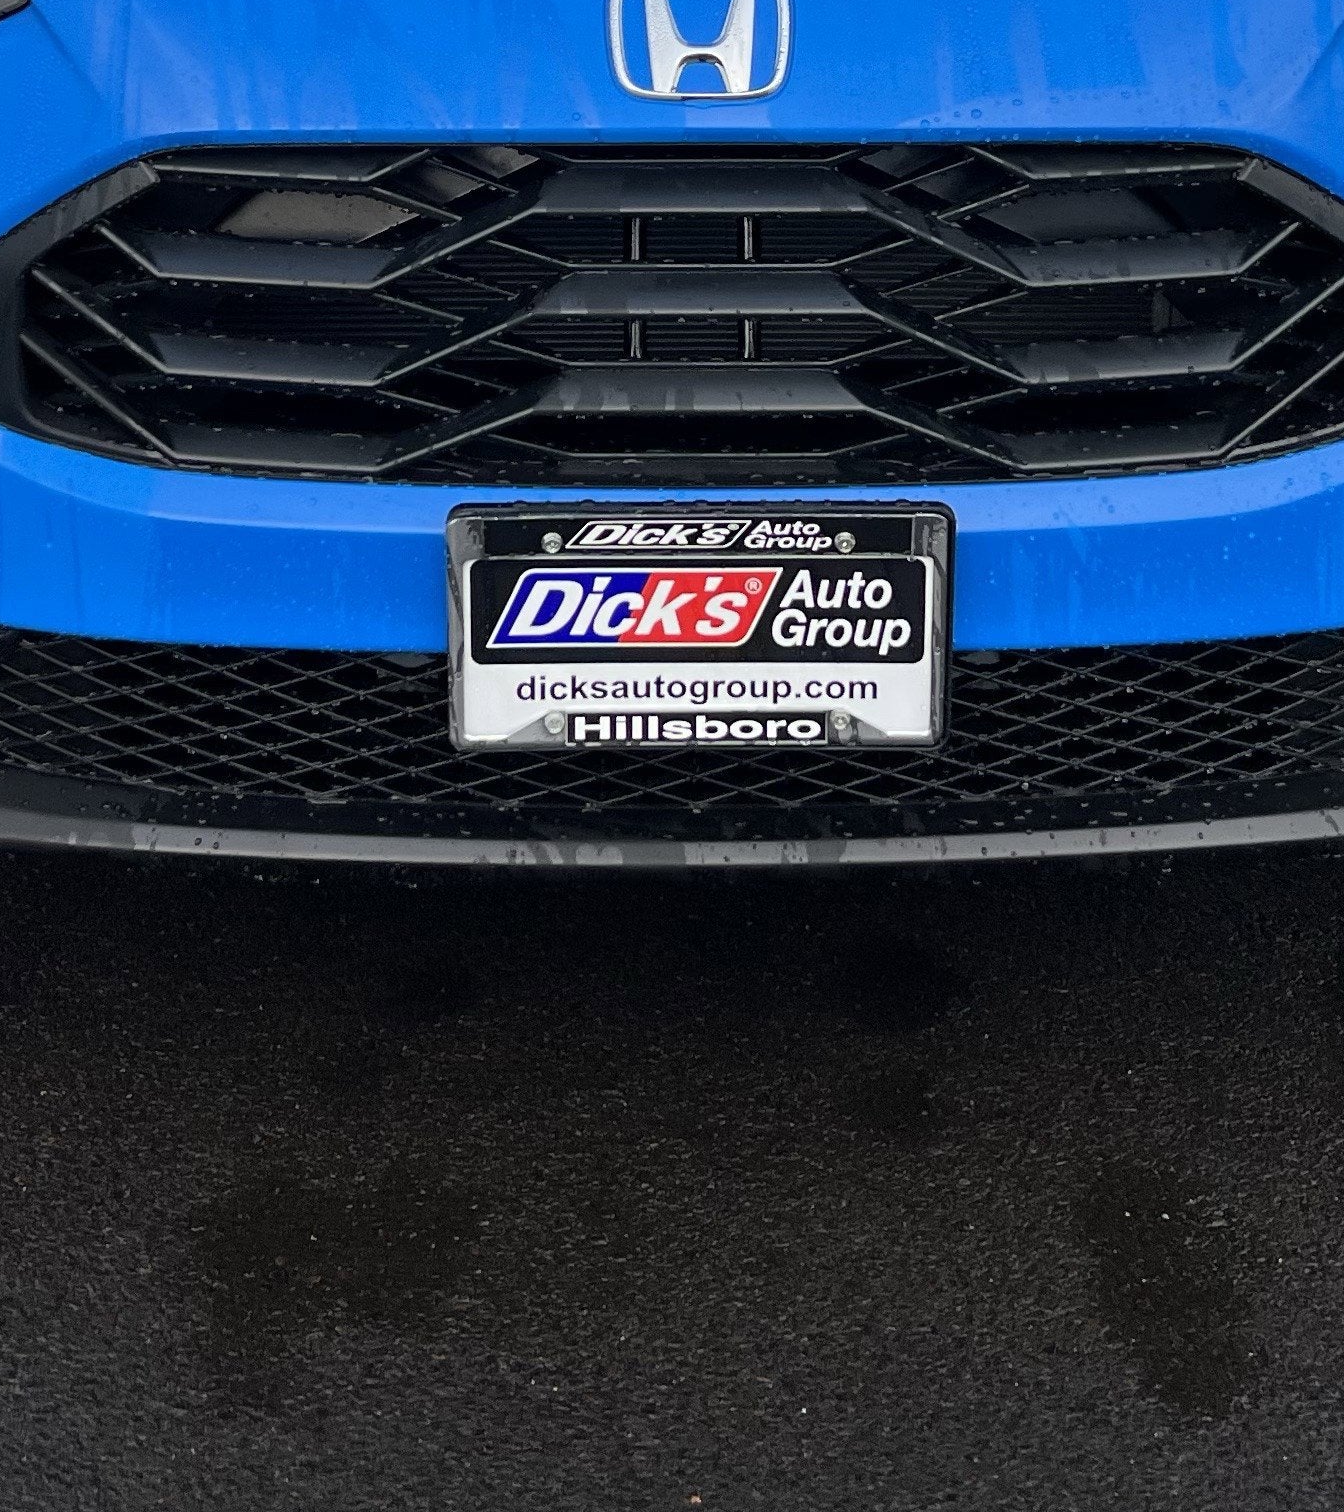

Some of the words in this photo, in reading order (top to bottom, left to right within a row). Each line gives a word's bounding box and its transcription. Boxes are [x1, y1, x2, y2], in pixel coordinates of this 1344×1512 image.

[579, 522, 732, 547] Dick's
[751, 519, 822, 536] Auto
[743, 533, 833, 552] Group
[779, 569, 894, 610] Auto
[507, 574, 749, 638] Dick's
[771, 609, 912, 656] Group
[516, 674, 880, 704] dicksautogroup.com
[573, 715, 823, 741] Hillsboro
